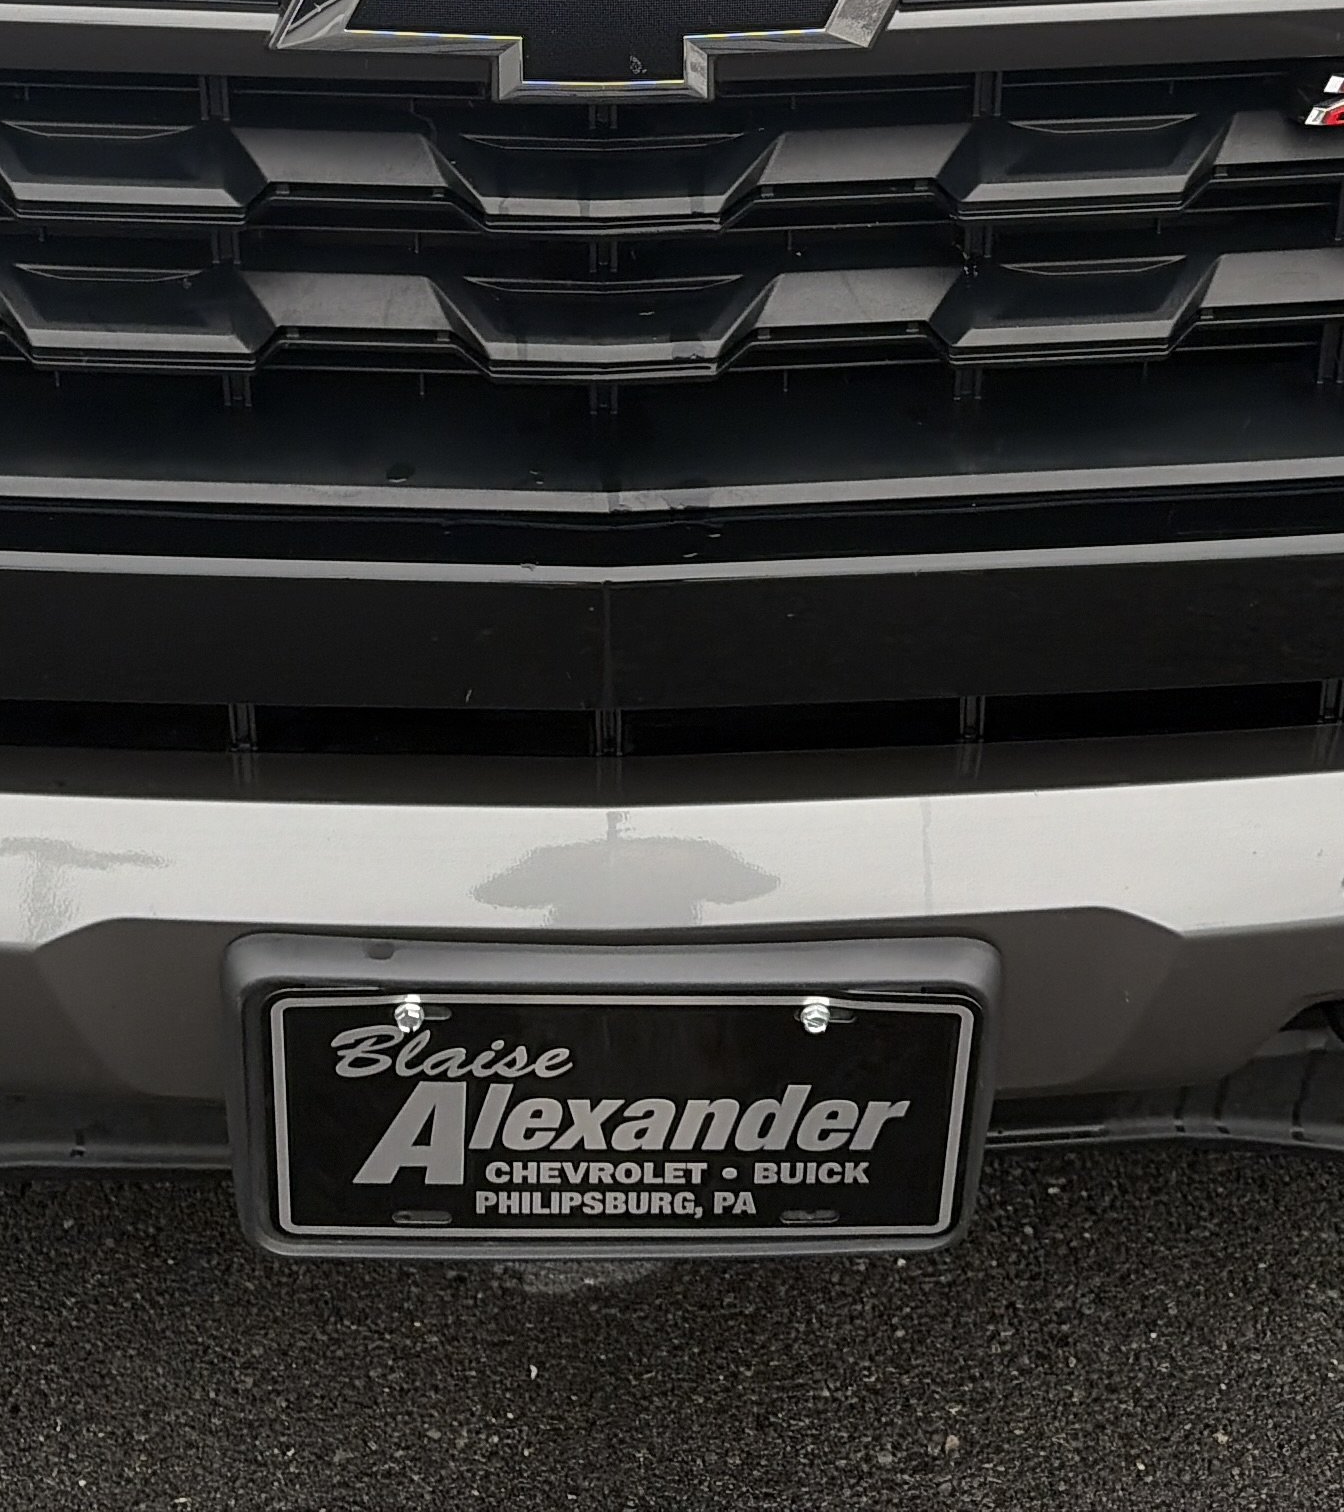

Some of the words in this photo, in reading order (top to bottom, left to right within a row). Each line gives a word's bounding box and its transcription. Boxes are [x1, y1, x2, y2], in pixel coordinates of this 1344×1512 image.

[330, 1024, 574, 1079] Blaise
[352, 1080, 911, 1186] Alexander
[485, 1161, 708, 1185] CHEVROLET
[753, 1161, 870, 1185] BUICK
[475, 1191, 704, 1219] PHILIPSBURG,
[713, 1191, 757, 1215] PA
